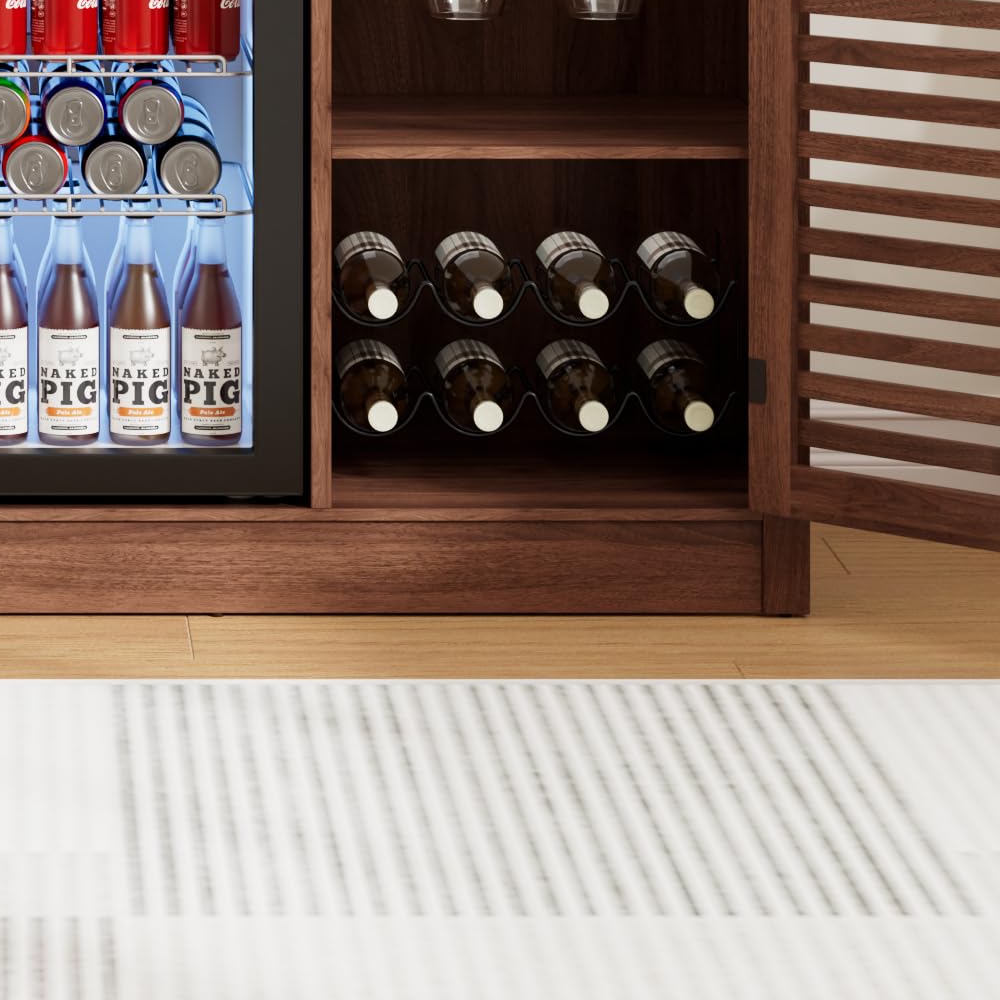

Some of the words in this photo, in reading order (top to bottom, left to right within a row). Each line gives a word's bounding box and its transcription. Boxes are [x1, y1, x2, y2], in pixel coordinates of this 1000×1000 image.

[41, 366, 96, 378] NAKED
[112, 366, 168, 378] NAKED
[184, 366, 240, 378] NAKED
[41, 379, 96, 405] PIG
[112, 379, 168, 405] PIG
[184, 379, 240, 405] PIG
